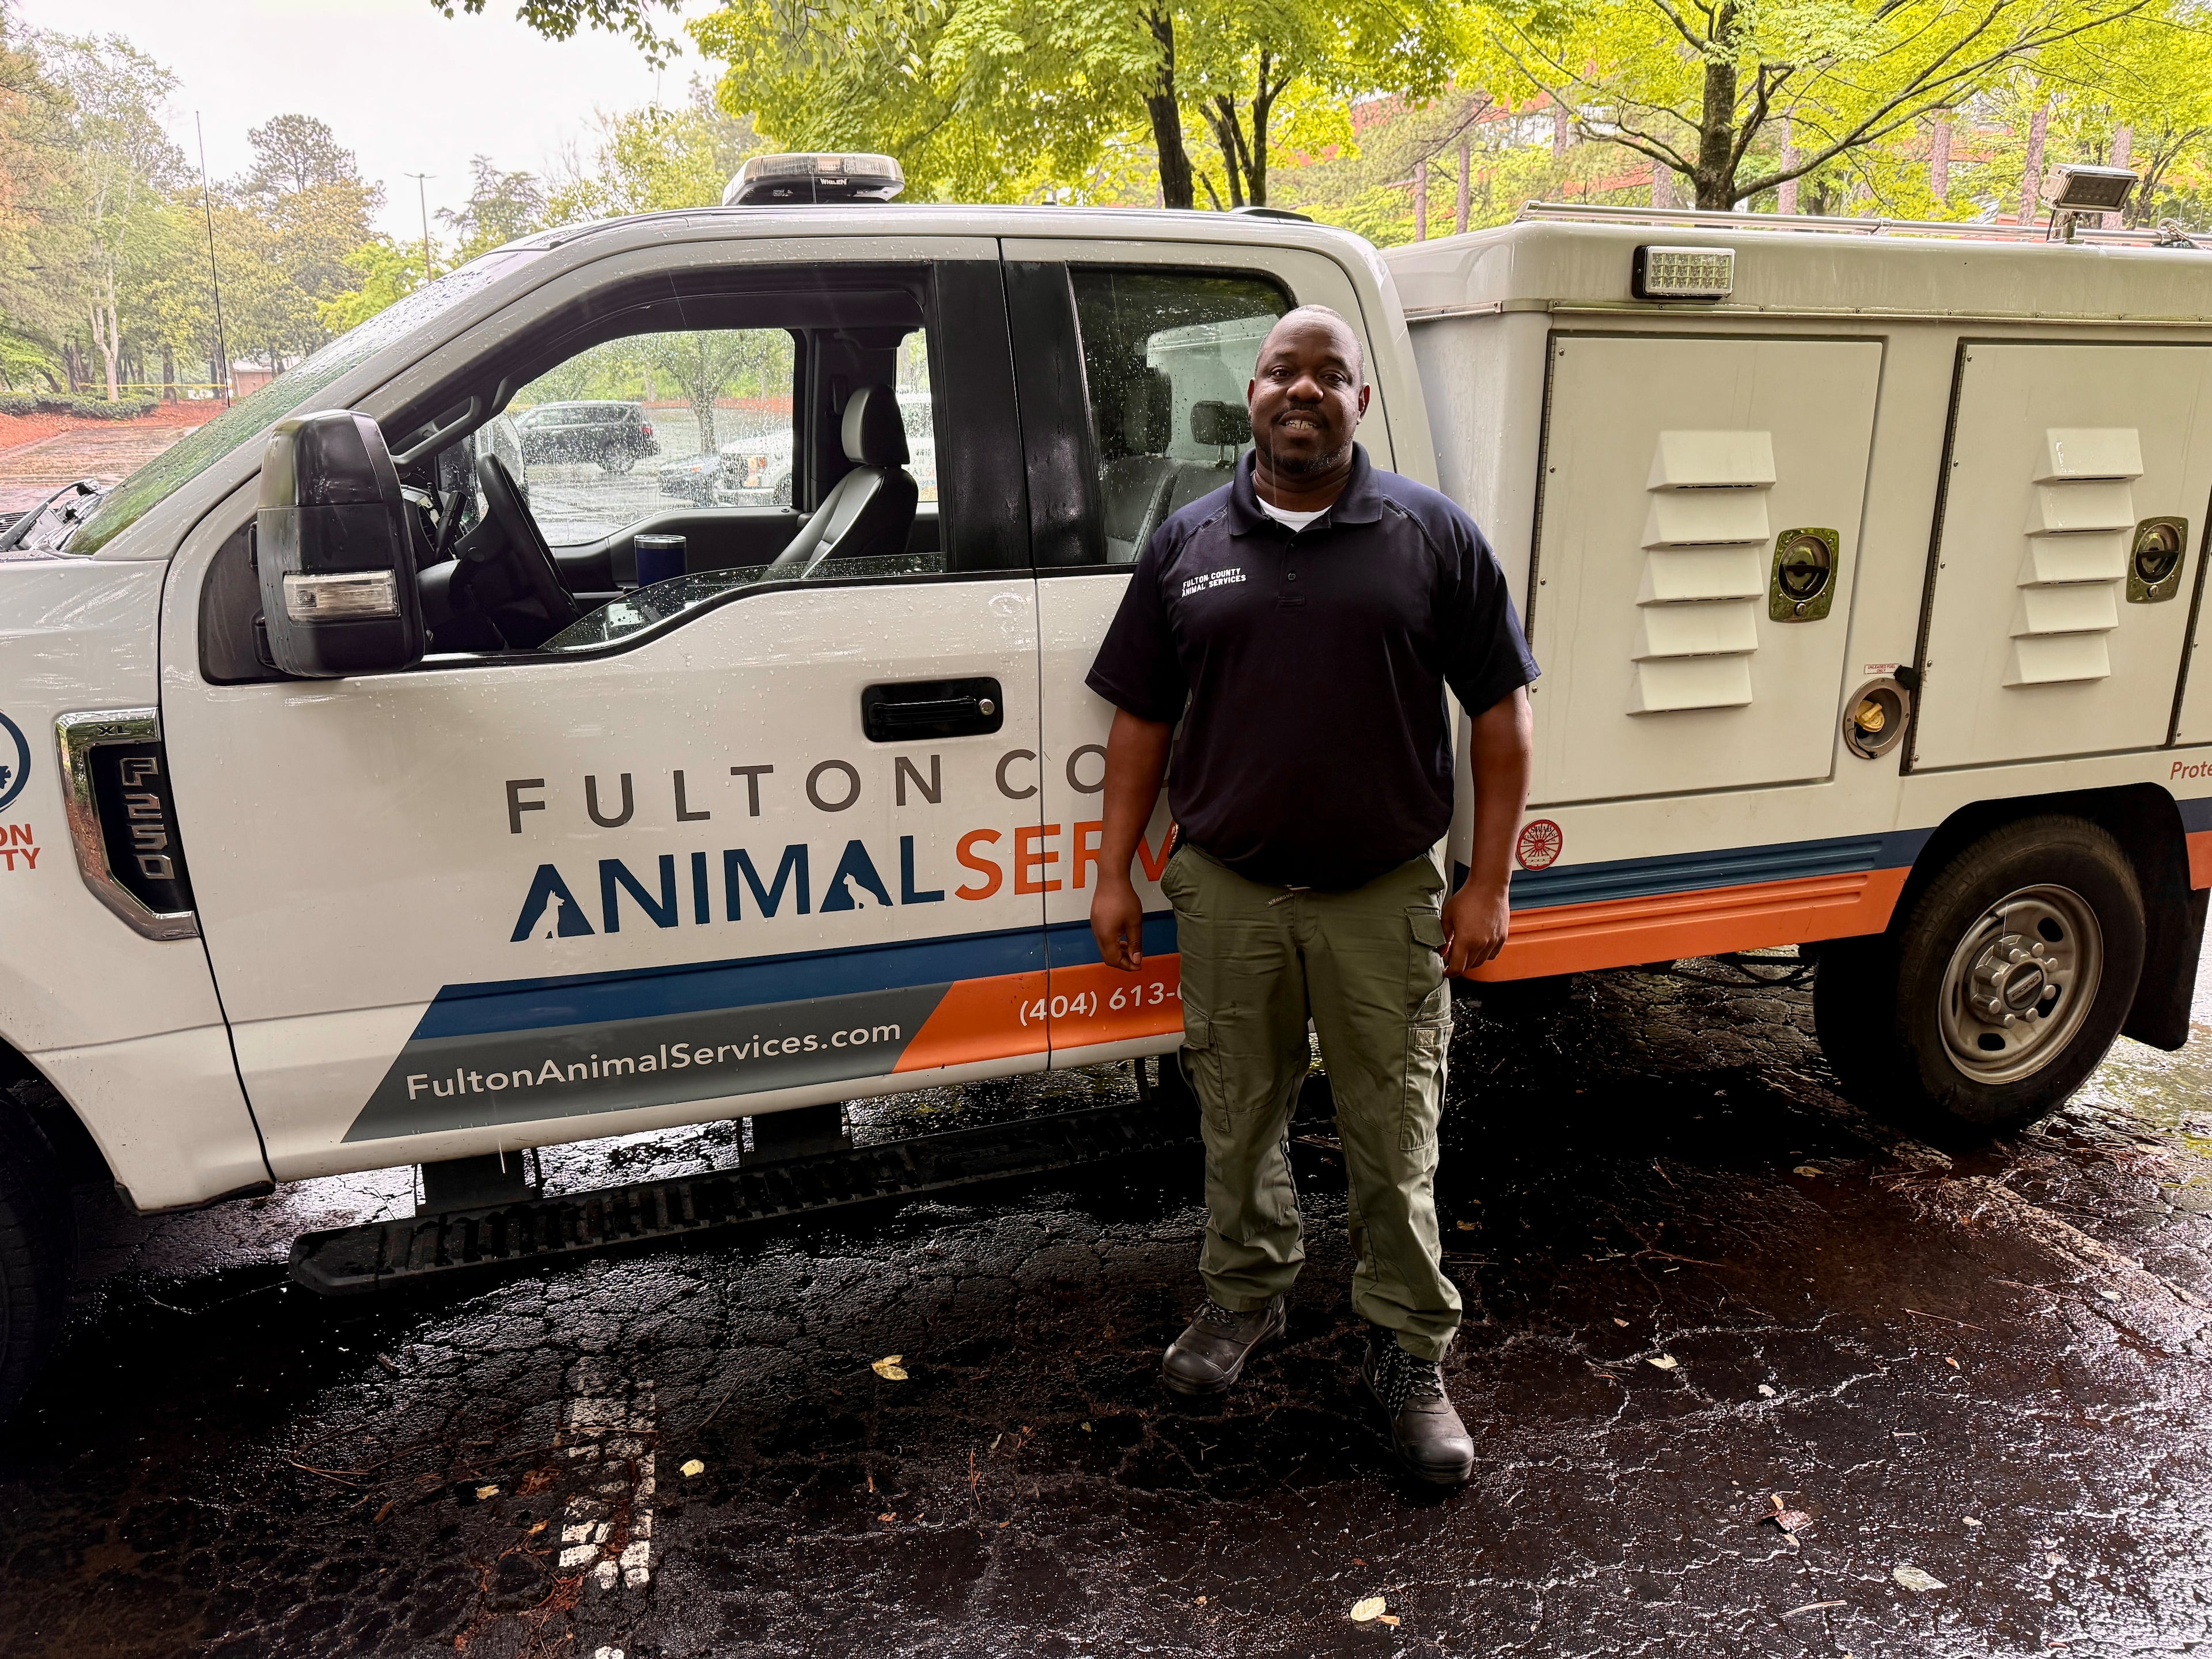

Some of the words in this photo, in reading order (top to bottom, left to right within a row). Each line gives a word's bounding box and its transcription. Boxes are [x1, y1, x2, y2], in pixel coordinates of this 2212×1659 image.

[1181, 584, 1206, 597] ANIMAL
[1209, 575, 1247, 588] SERVICES
[1183, 574, 1209, 589] FULTON
[1211, 568, 1241, 579] COUNTY
[97, 725, 131, 736] XL
[506, 755, 941, 834] FULTON
[119, 757, 175, 879] F250
[2012, 976, 2039, 998] FORD
[1020, 990, 1098, 1027] (404)
[1109, 982, 1183, 1010] 613-
[406, 1023, 901, 1101] FultonAnimalServices.com
